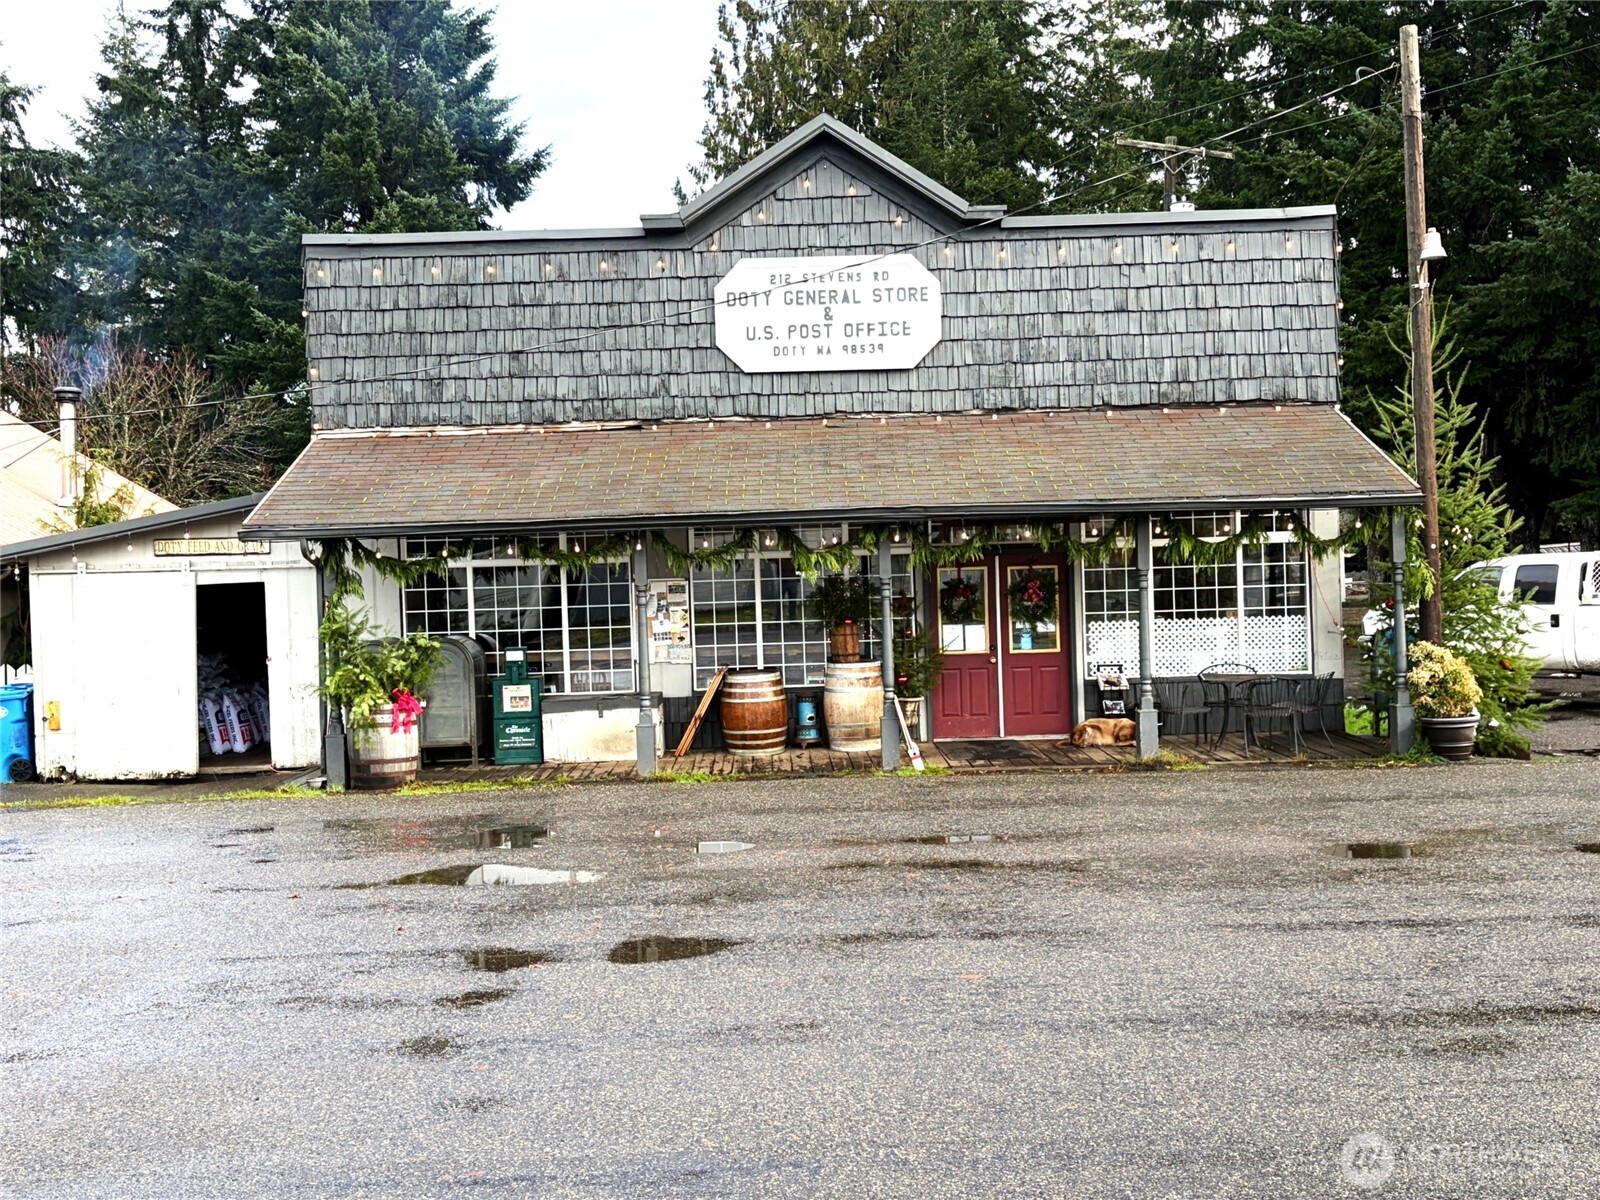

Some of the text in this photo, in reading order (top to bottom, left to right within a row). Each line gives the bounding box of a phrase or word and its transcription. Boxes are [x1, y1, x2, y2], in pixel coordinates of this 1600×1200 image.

[770, 270, 889, 285] 212 STEVENS RD
[726, 286, 929, 308] DOTY GENERAL STORE
[824, 306, 834, 321] &
[746, 320, 912, 341] U.S. POST OFFICE
[773, 345, 806, 357] DOTY
[841, 343, 884, 355] 98539
[157, 541, 183, 553] DOTY
[187, 541, 211, 553] FEED
[214, 540, 234, 552] AND
